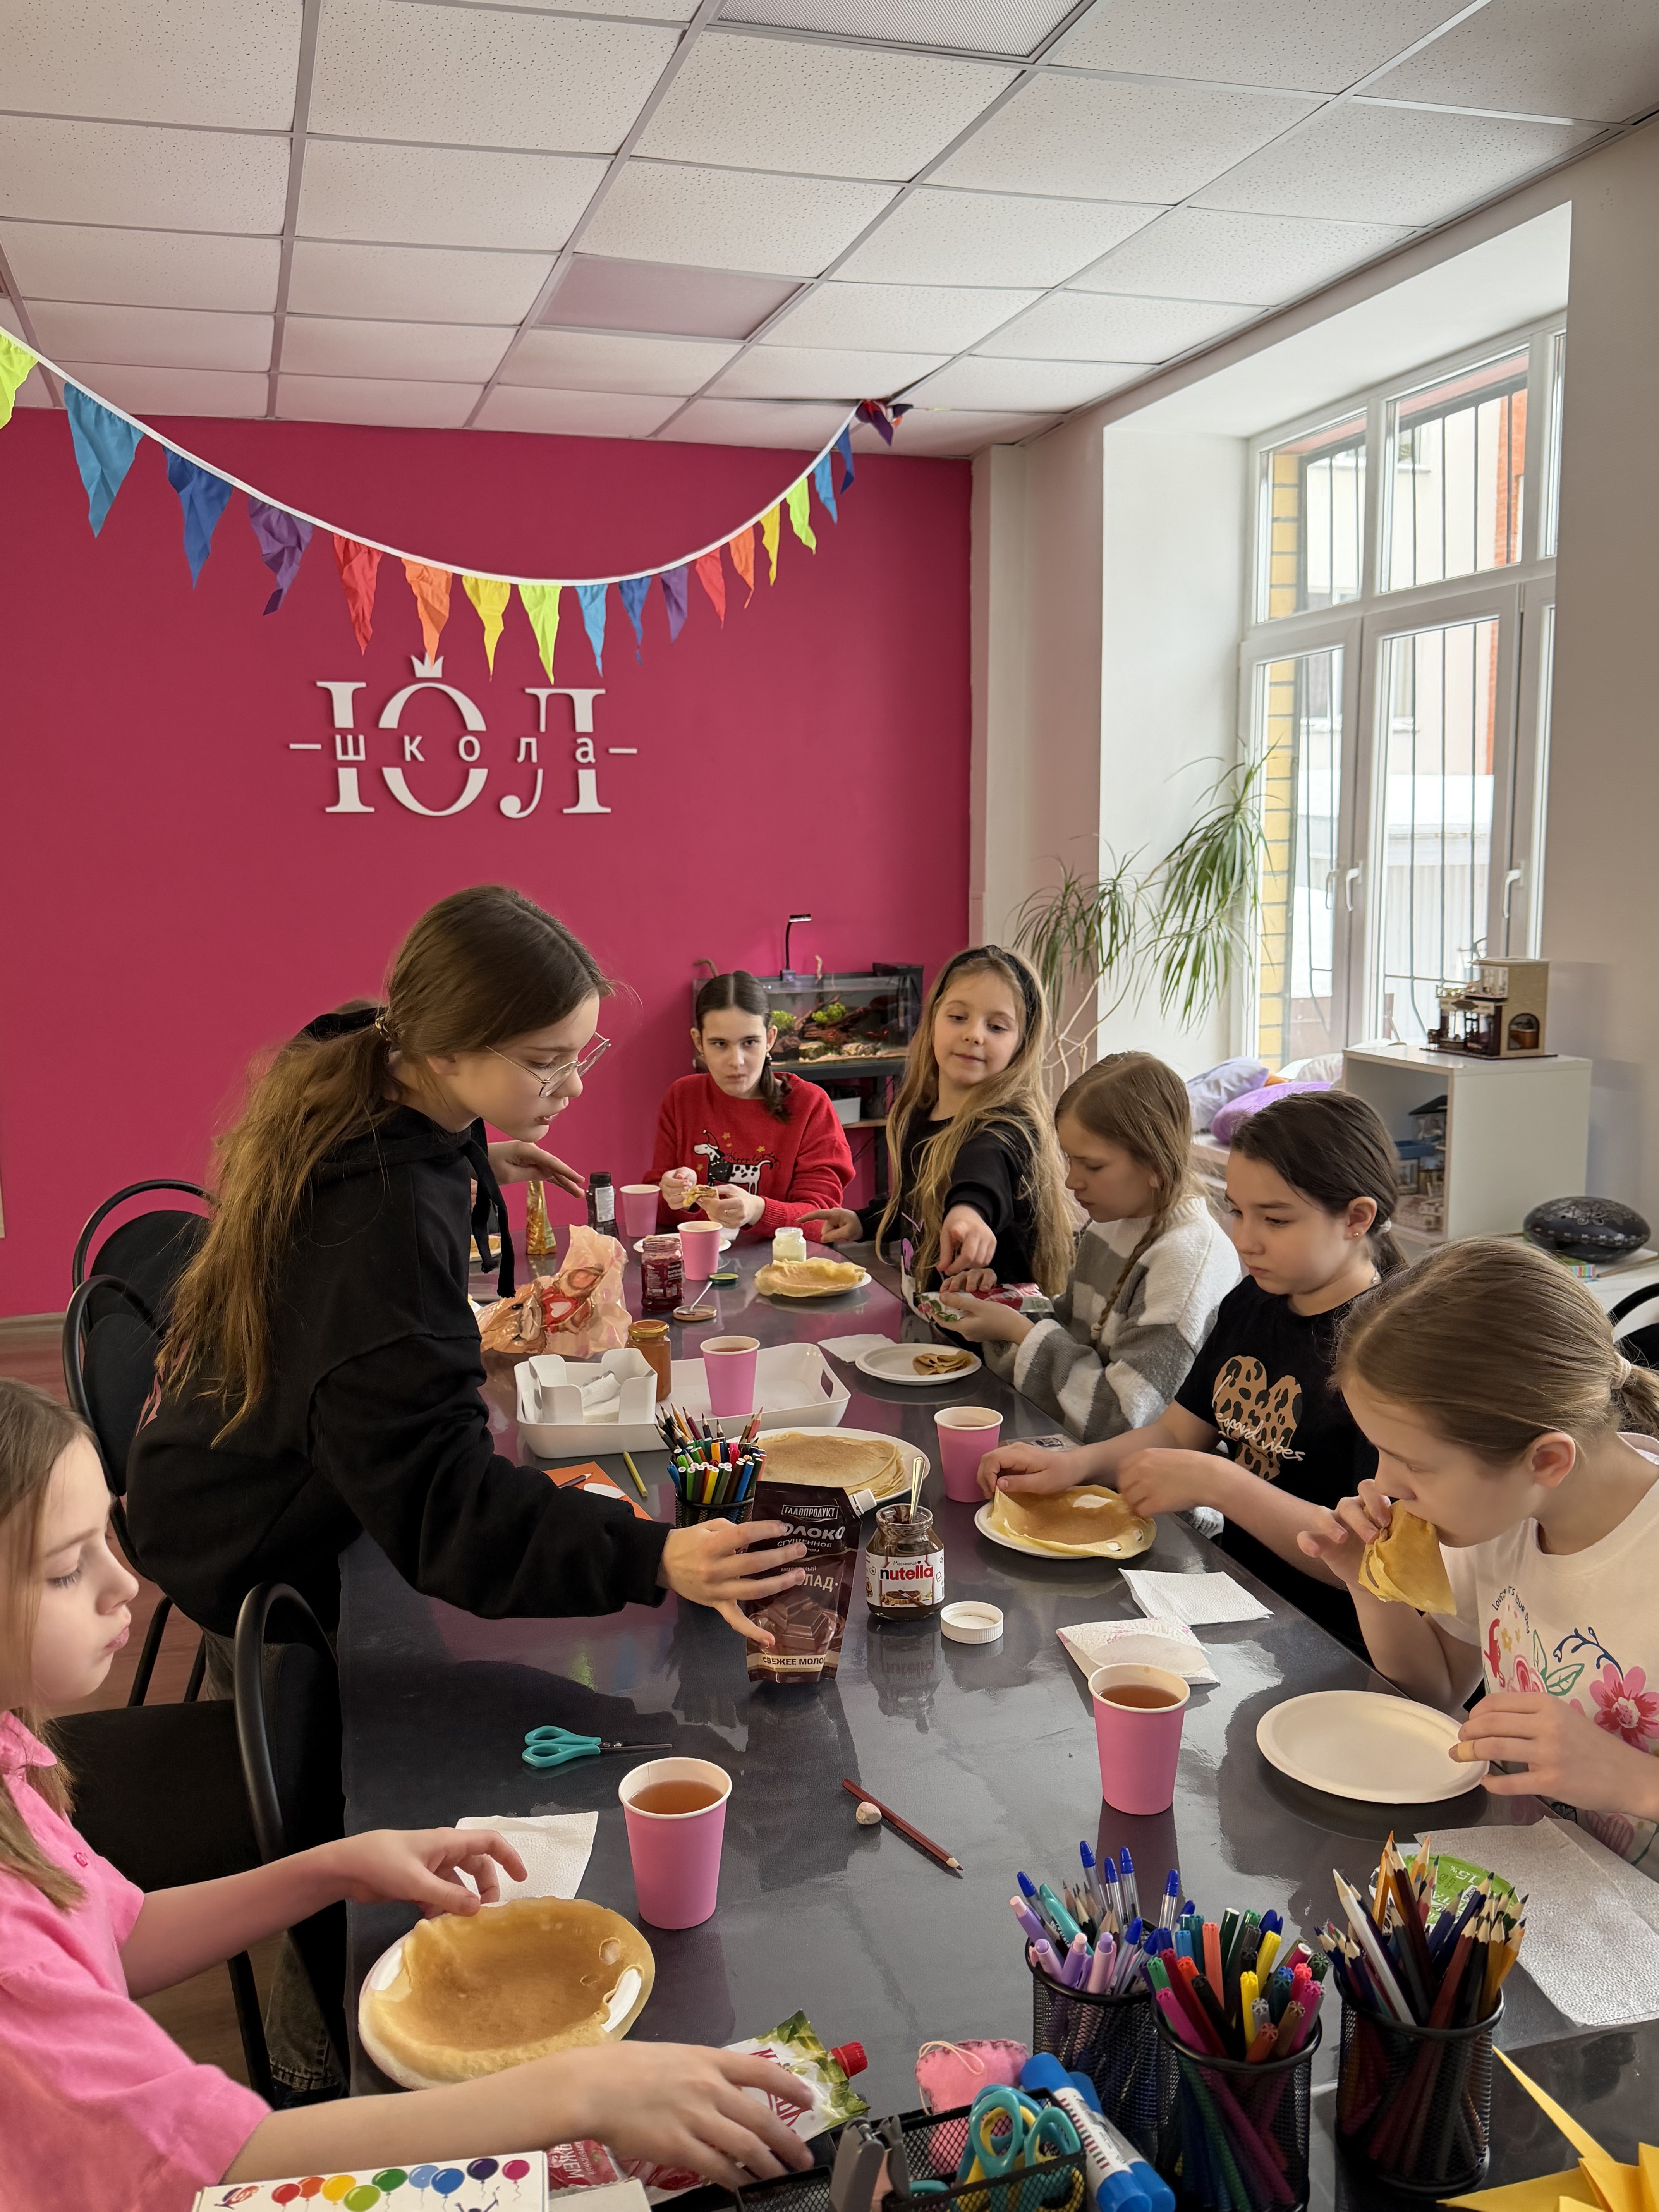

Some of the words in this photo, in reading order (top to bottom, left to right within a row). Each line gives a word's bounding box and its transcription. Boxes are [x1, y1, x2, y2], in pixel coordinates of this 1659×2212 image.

[335, 734, 596, 763] школа
[1261, 1436, 1306, 1462] vibes
[785, 1507, 836, 1517] ГЛАВПРОДУКТ
[783, 1523, 845, 1540] ОЛОКО
[880, 1565, 933, 1580] nutella
[763, 1657, 797, 1665] СВЕЖЕЕ
